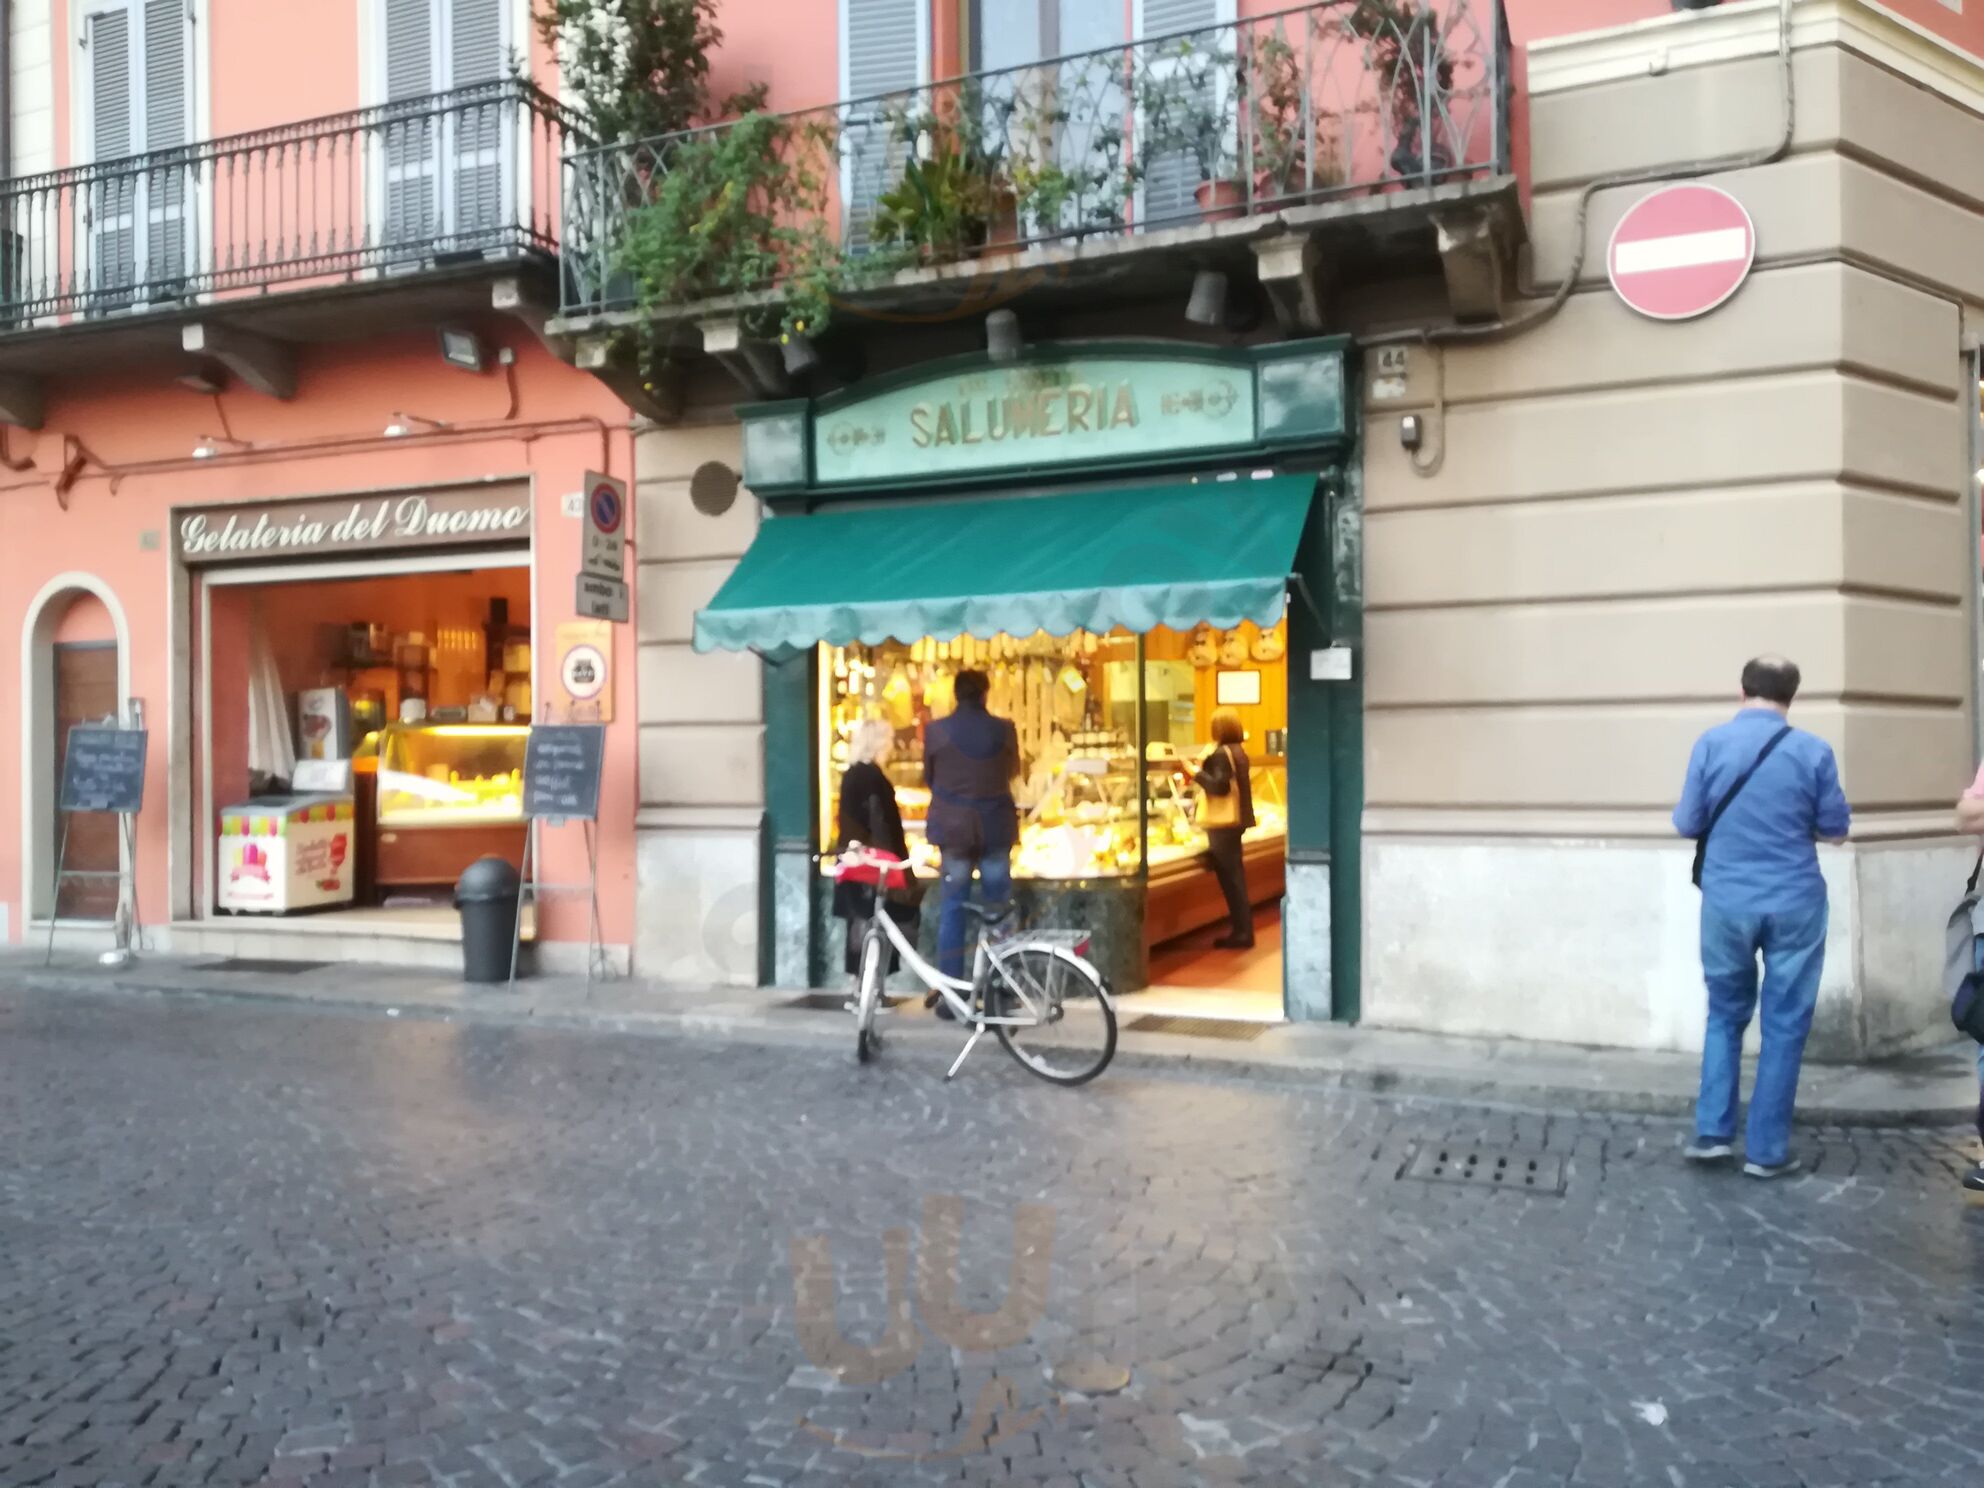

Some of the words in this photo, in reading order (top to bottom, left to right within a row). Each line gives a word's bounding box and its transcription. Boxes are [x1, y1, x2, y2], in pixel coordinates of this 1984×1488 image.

[1382, 351, 1405, 367] 44
[910, 379, 1140, 448] SALUMERIA
[181, 513, 329, 553] Gelateria
[331, 499, 391, 542] del
[394, 495, 529, 537] Duomo
